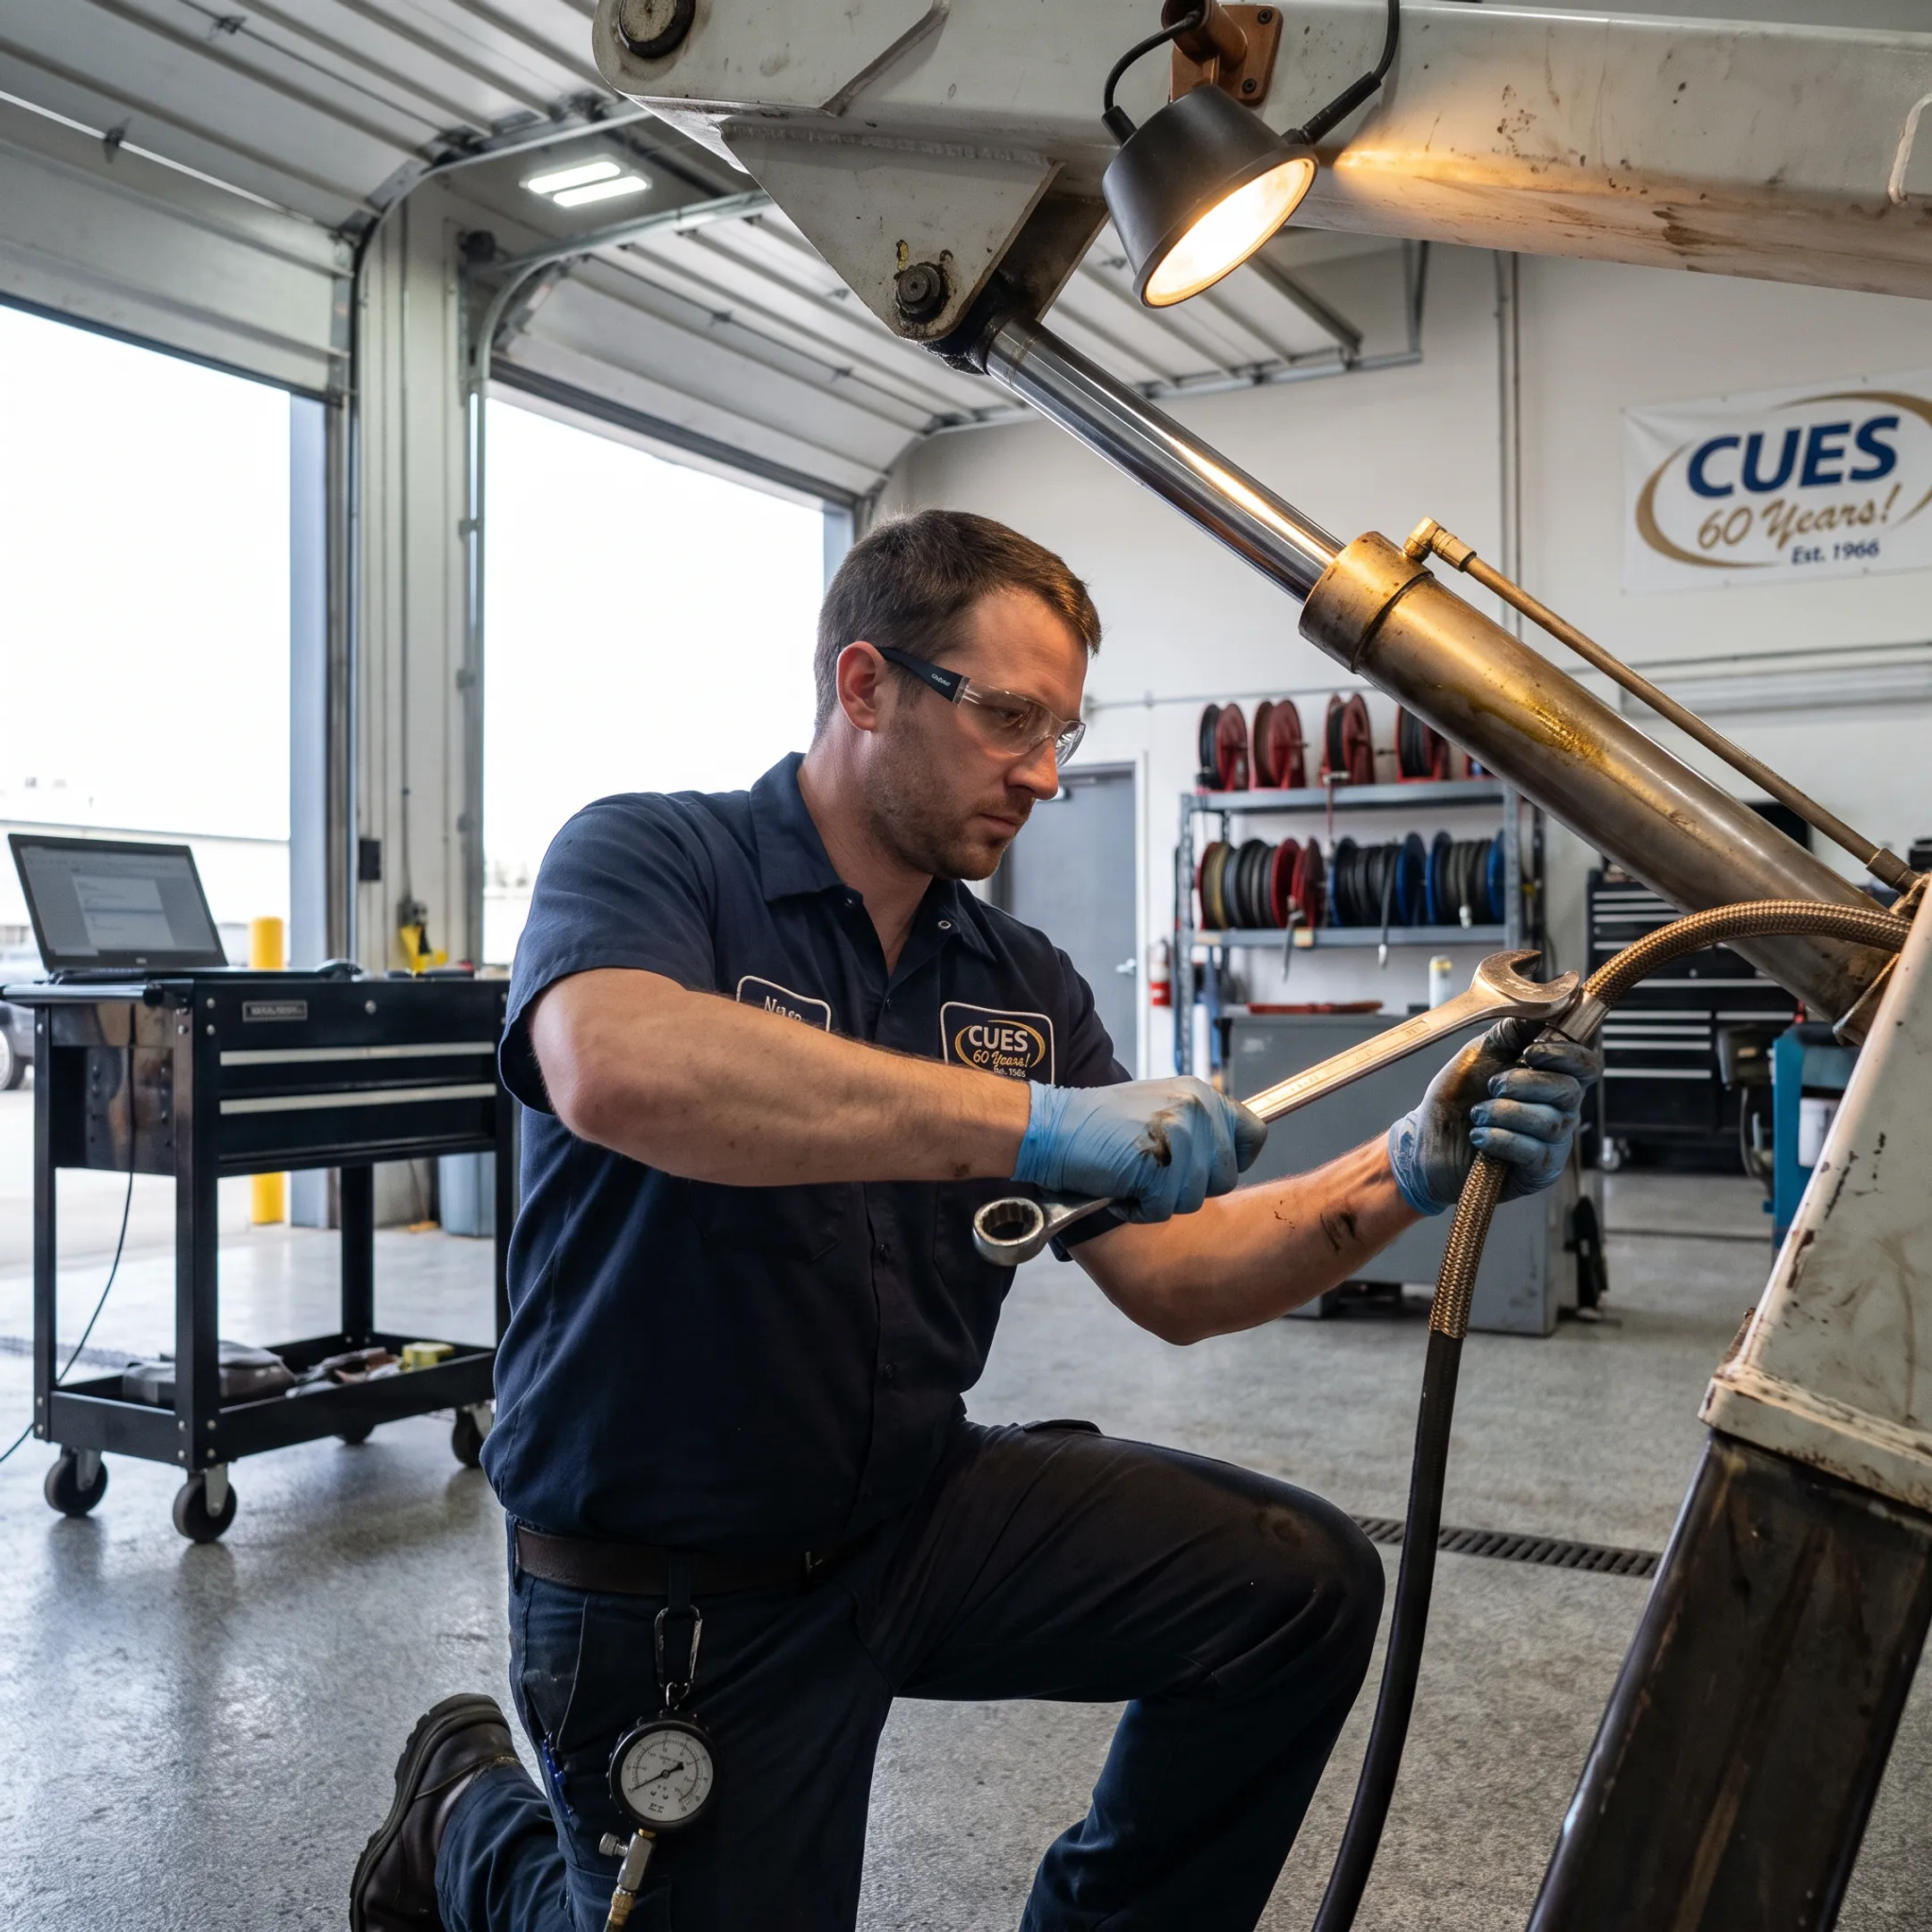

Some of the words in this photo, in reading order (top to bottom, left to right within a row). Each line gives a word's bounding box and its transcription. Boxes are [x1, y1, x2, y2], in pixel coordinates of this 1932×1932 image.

[1686, 414, 1901, 500] CUES
[1697, 506, 1754, 550] 60
[1760, 481, 1903, 551] Years!
[1791, 544, 1826, 565] Est.
[1833, 538, 1880, 561] 1966
[969, 1025, 1028, 1053] CUES
[972, 1049, 989, 1063] 60
